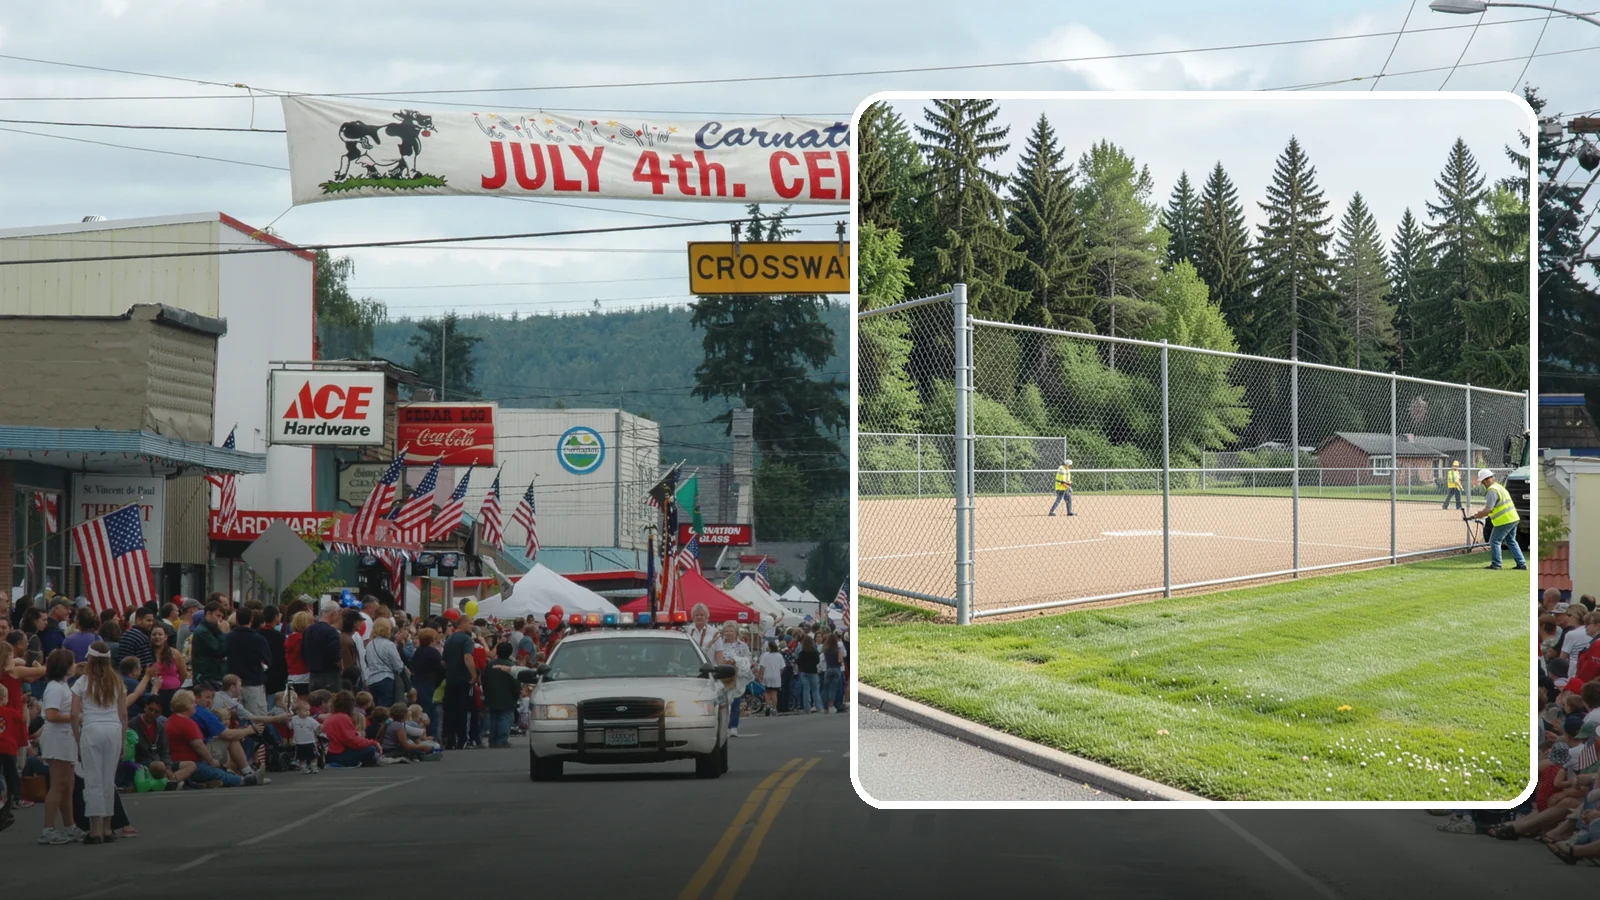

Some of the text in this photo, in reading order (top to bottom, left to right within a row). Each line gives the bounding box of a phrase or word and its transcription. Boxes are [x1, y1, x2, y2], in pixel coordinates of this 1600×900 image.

[481, 141, 604, 192] JULY
[632, 150, 746, 198] 4th.
[697, 254, 850, 280] CROSSWA
[283, 380, 373, 420] ACE
[406, 409, 452, 422] CEDAR
[283, 421, 371, 436] Hardware
[353, 467, 384, 480] Simpl
[95, 485, 124, 494] Vincent
[126, 485, 136, 494] de
[138, 486, 155, 495] Paul
[213, 515, 330, 535] HARDARE
[688, 526, 741, 535] CRNATION
[699, 535, 731, 543] GLASS
